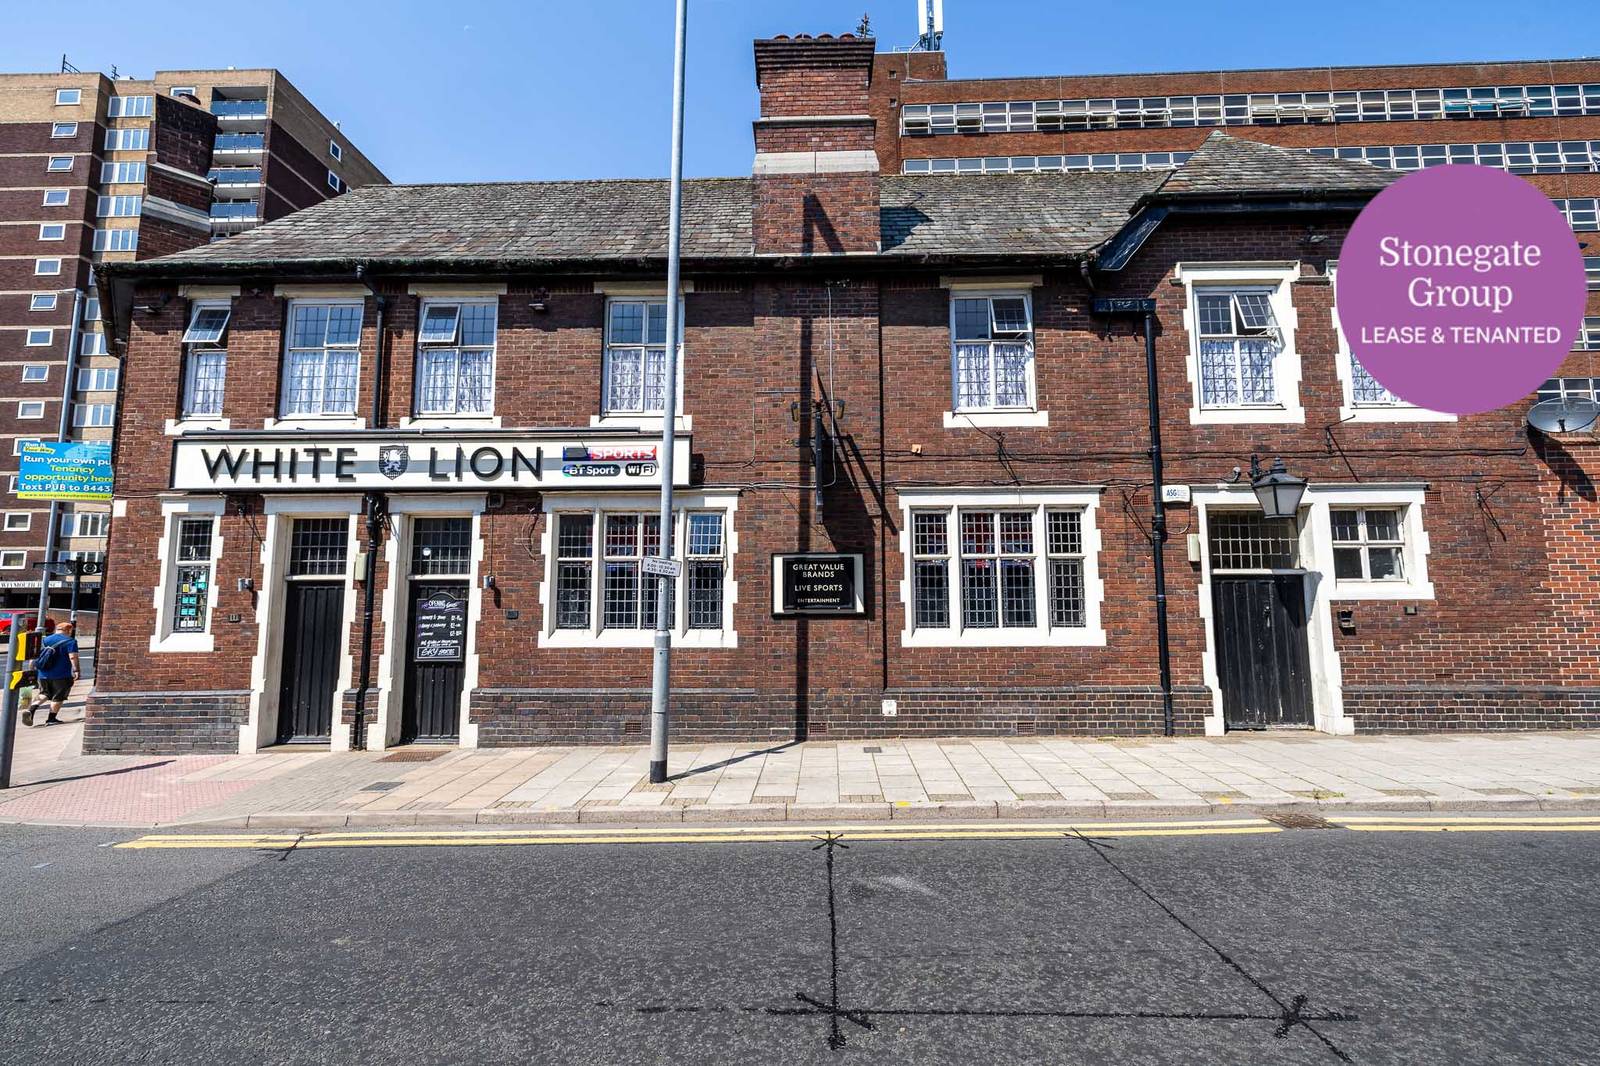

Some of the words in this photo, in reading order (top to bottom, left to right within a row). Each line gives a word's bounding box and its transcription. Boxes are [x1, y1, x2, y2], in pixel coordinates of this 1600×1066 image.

[592, 446, 654, 459] SPORTS
[23, 455, 44, 463] Run
[201, 448, 357, 482] WHITE
[428, 446, 543, 481] LION
[50, 464, 95, 474] Tenancy
[569, 466, 586, 475] BT
[586, 466, 615, 475] Sport
[24, 474, 89, 483] opportunity
[21, 483, 43, 491] Text
[45, 483, 66, 491] PUB
[792, 563, 818, 571] GREAT
[819, 563, 845, 571] VALUE
[794, 584, 812, 592] LIVE
[813, 584, 843, 592] SPORTS
